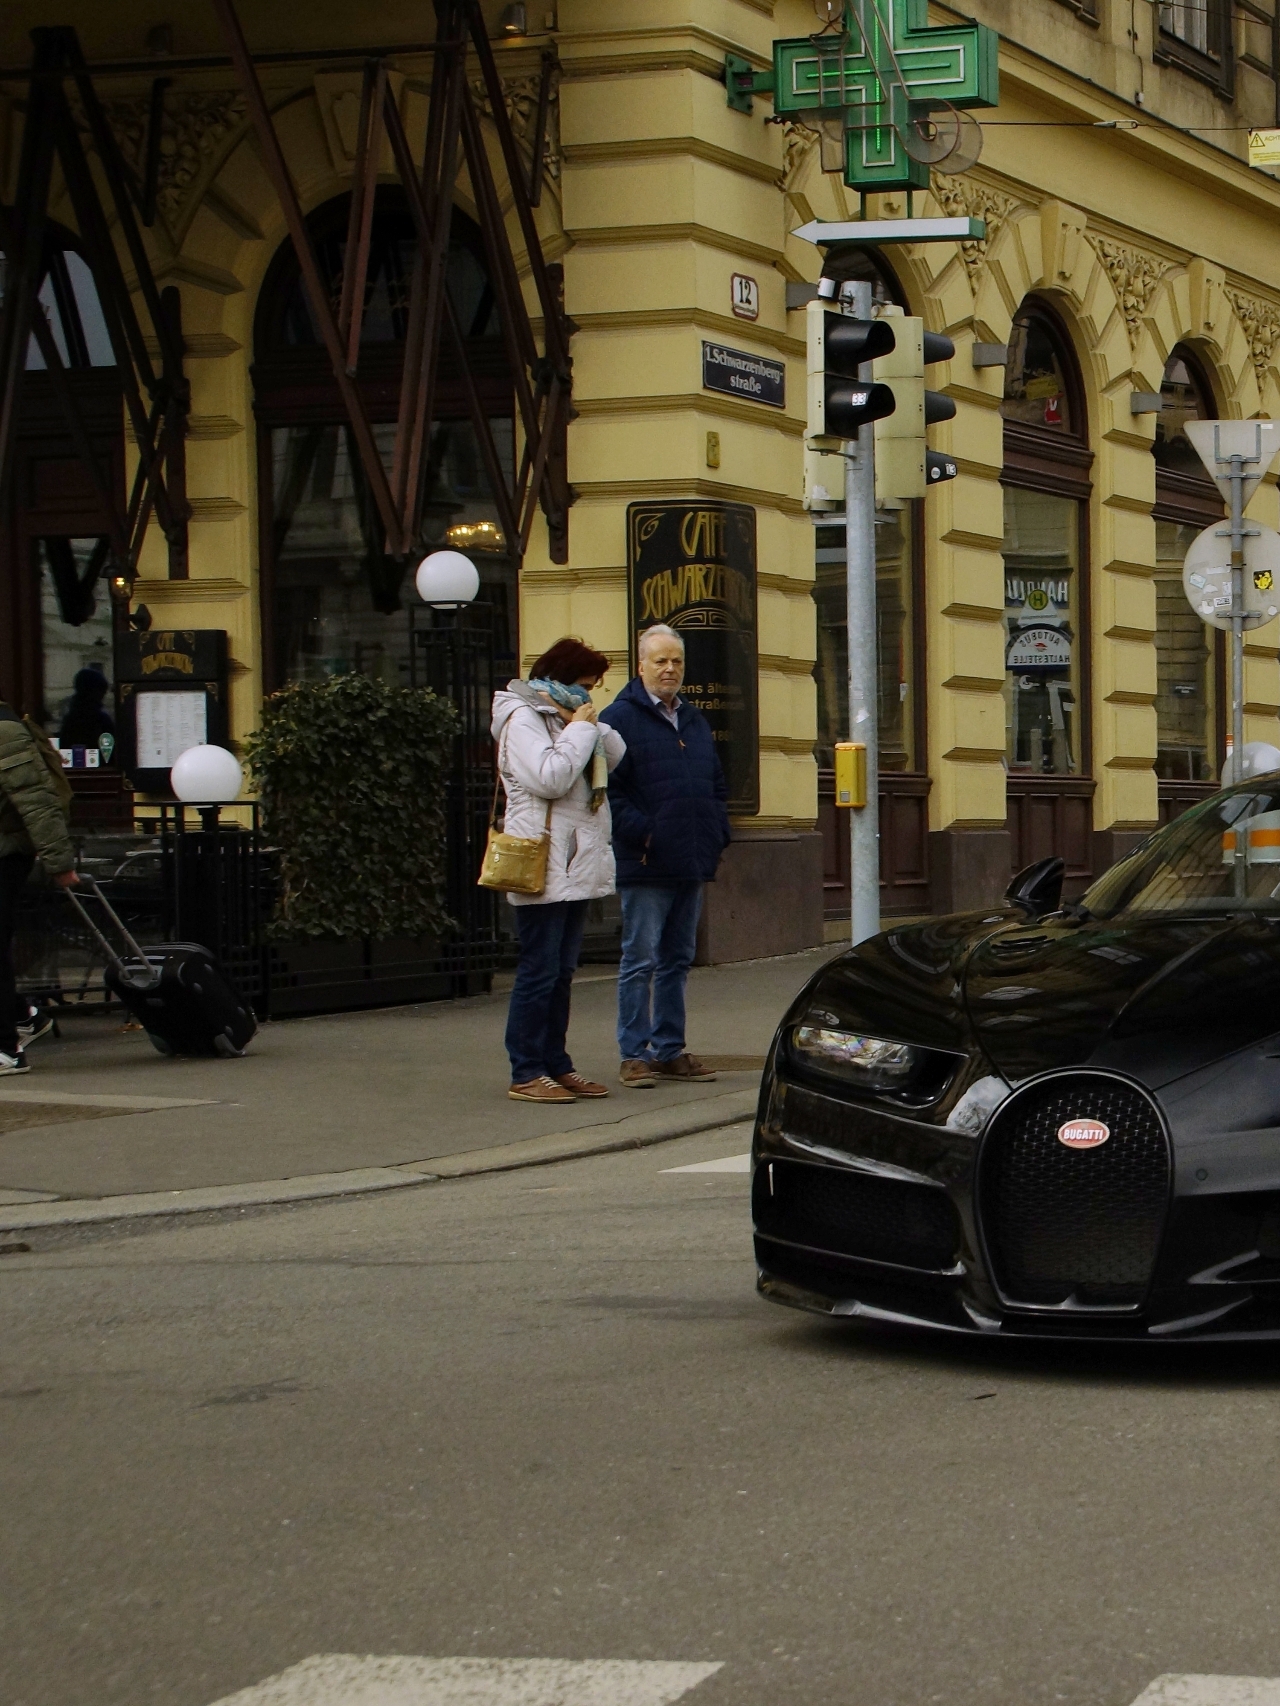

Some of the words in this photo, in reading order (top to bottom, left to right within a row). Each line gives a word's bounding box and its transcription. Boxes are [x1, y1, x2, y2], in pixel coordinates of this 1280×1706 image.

[739, 279, 752, 305] 12
[730, 374, 762, 394] straße
[1063, 1128, 1104, 1140] BUGATTI
